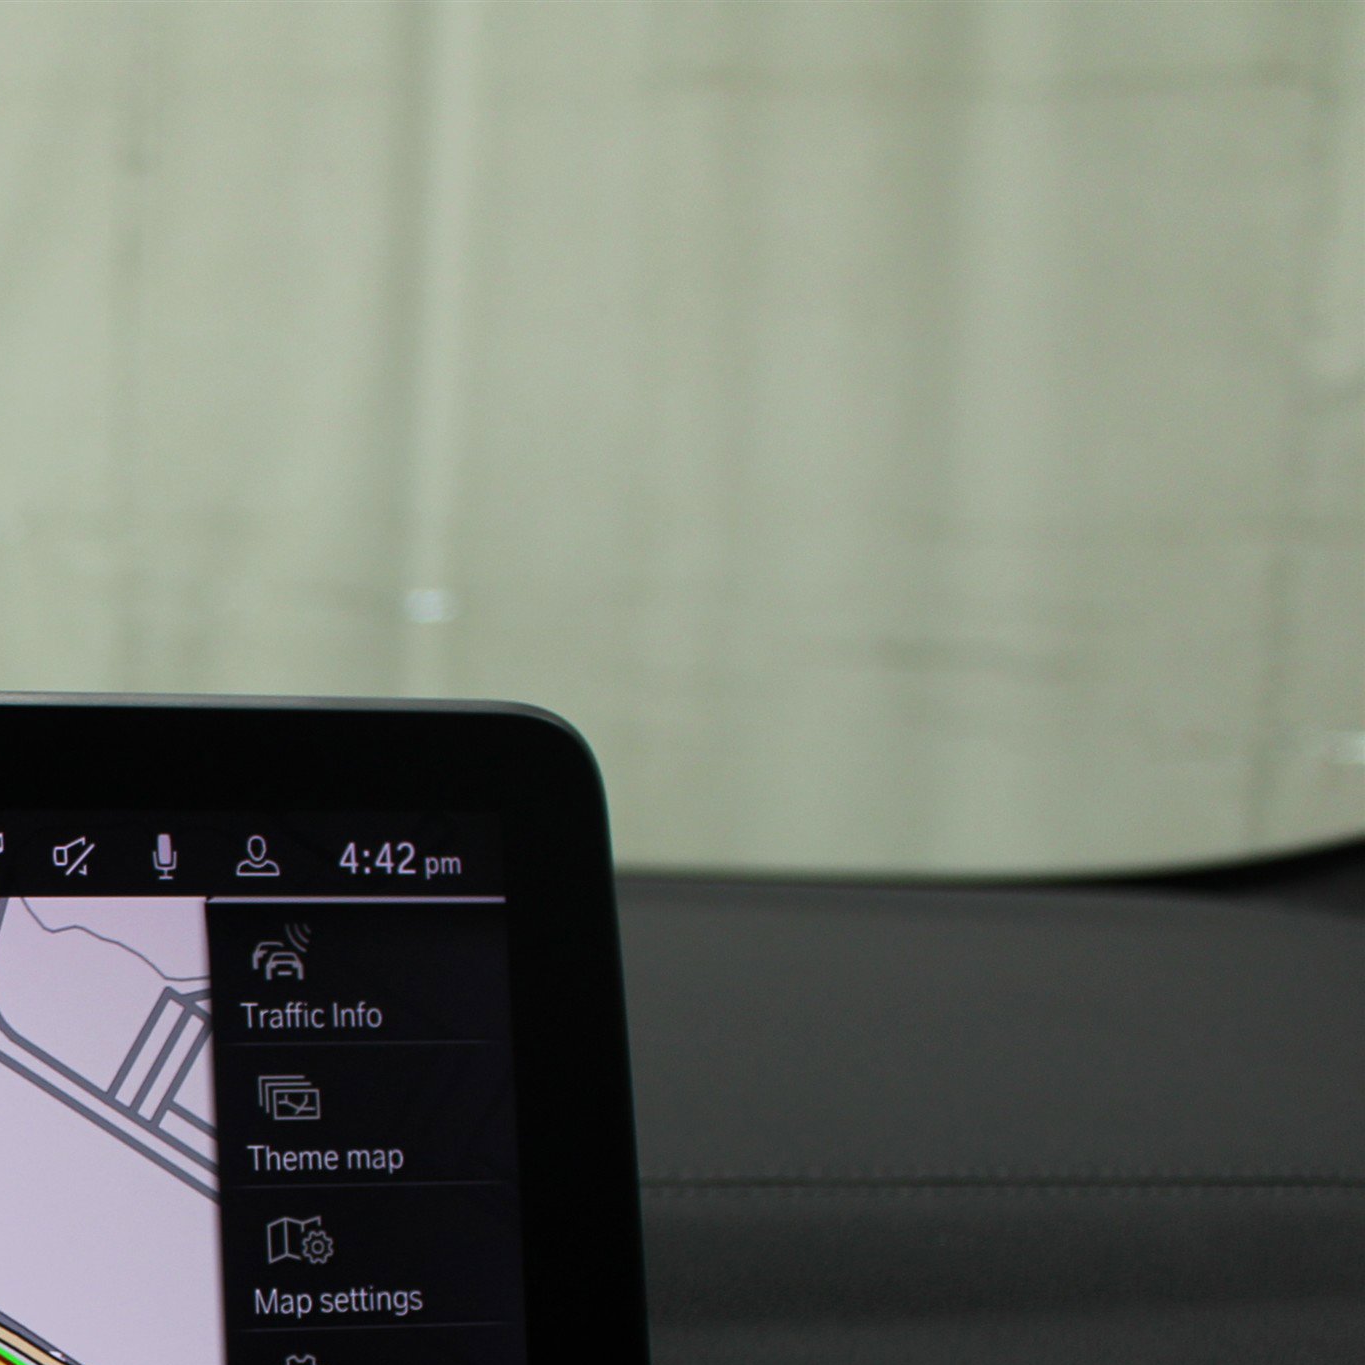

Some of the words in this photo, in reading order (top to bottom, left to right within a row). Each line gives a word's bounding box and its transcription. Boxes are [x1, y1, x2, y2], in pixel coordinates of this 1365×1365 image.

[339, 842, 417, 875] 4:42
[424, 852, 462, 879] pm
[241, 1002, 324, 1030] Traffic
[333, 1001, 383, 1029] Info
[247, 1145, 338, 1172] Theme
[346, 1149, 404, 1176] map
[254, 1288, 312, 1319] Map
[320, 1286, 423, 1317] settings
